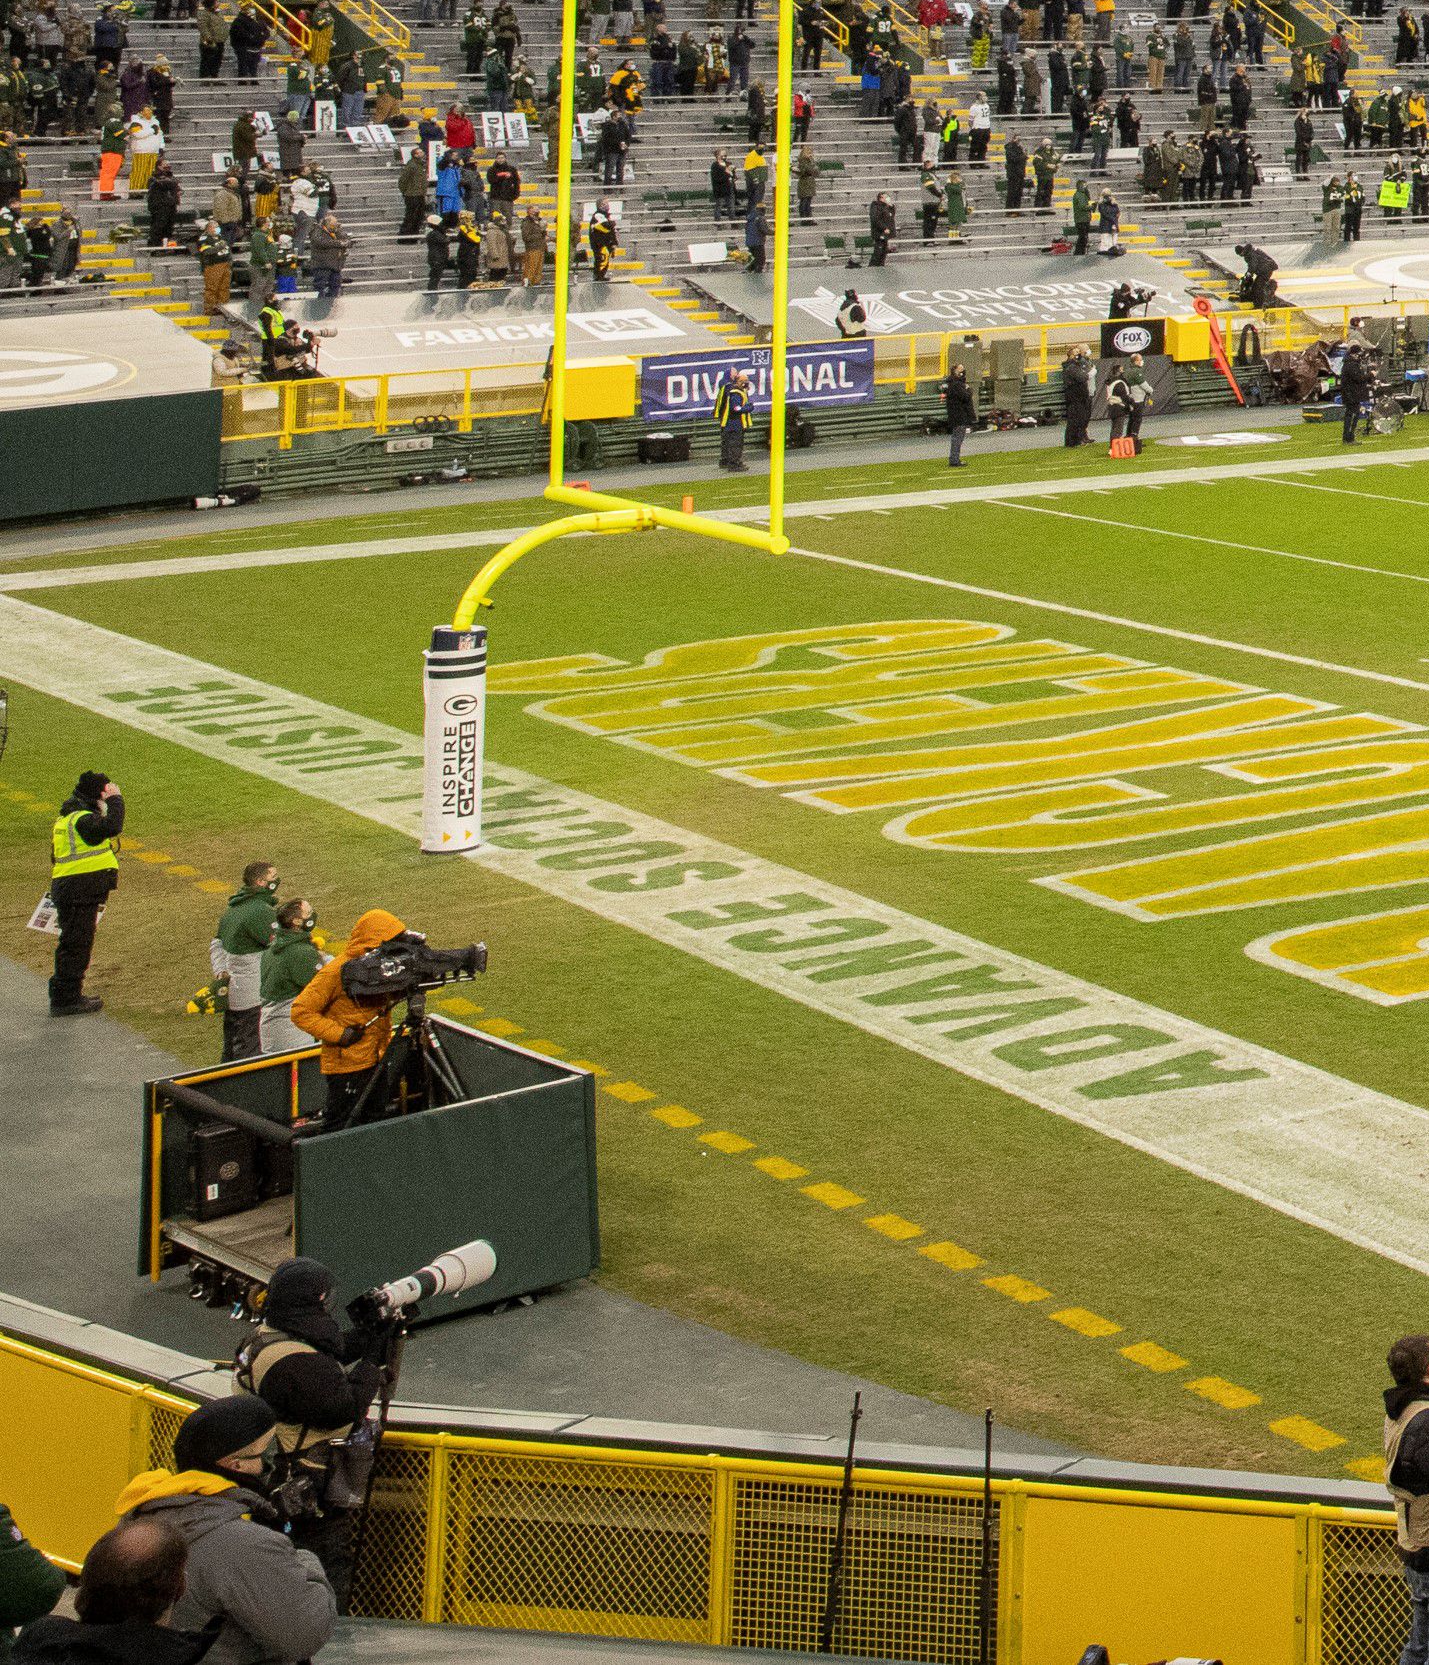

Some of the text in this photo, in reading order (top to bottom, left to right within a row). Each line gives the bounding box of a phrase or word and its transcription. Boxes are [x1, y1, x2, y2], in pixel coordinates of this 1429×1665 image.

[897, 278, 1152, 306] CONCORDIA
[394, 314, 662, 348] FABICK CAT
[1121, 331, 1143, 344] FOX
[1114, 438, 1133, 457] 10
[442, 725, 458, 815] INSPIRE
[457, 720, 477, 817] CHANGE
[663, 888, 1273, 1103] ADVANCE
